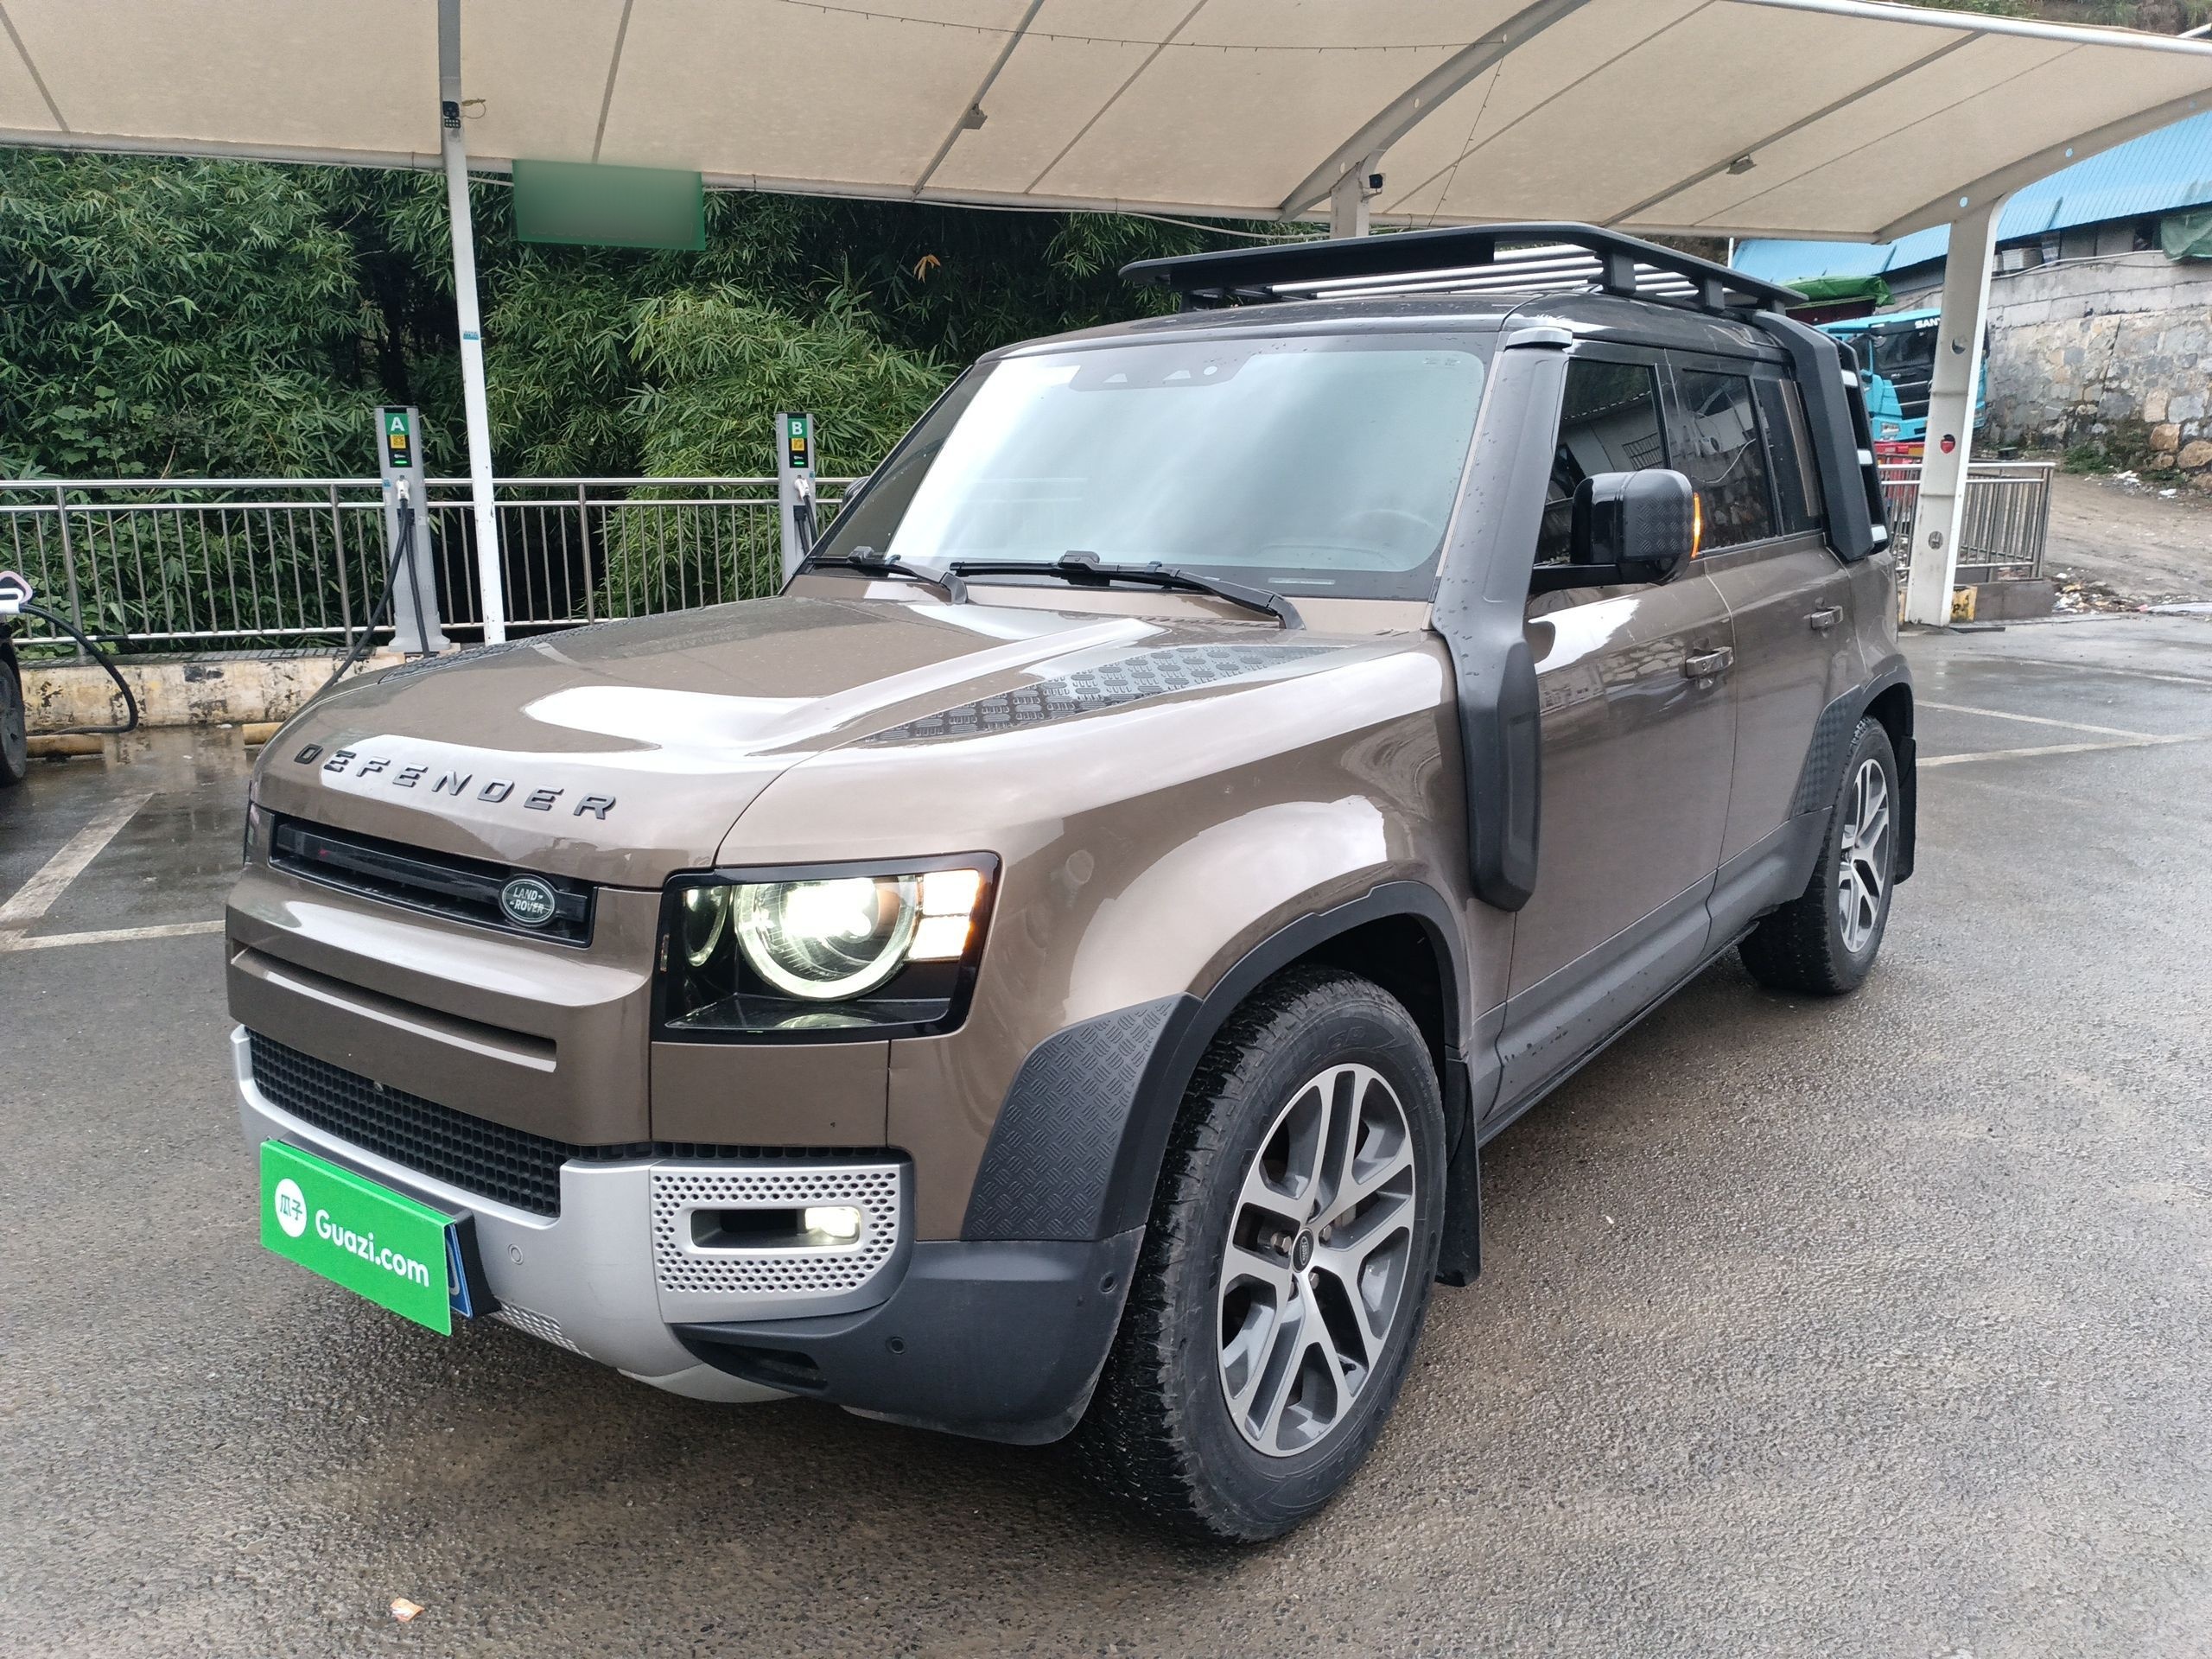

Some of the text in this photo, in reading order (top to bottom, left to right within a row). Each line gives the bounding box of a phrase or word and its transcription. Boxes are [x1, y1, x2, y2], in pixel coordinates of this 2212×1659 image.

[391, 416, 405, 431] A
[791, 421, 803, 435] B
[294, 743, 616, 820] DEFENDER
[512, 887, 538, 901] LAND
[513, 899, 545, 914] ROVER
[280, 1193, 302, 1221] 瓜子
[315, 1209, 429, 1287] Guazi.com
